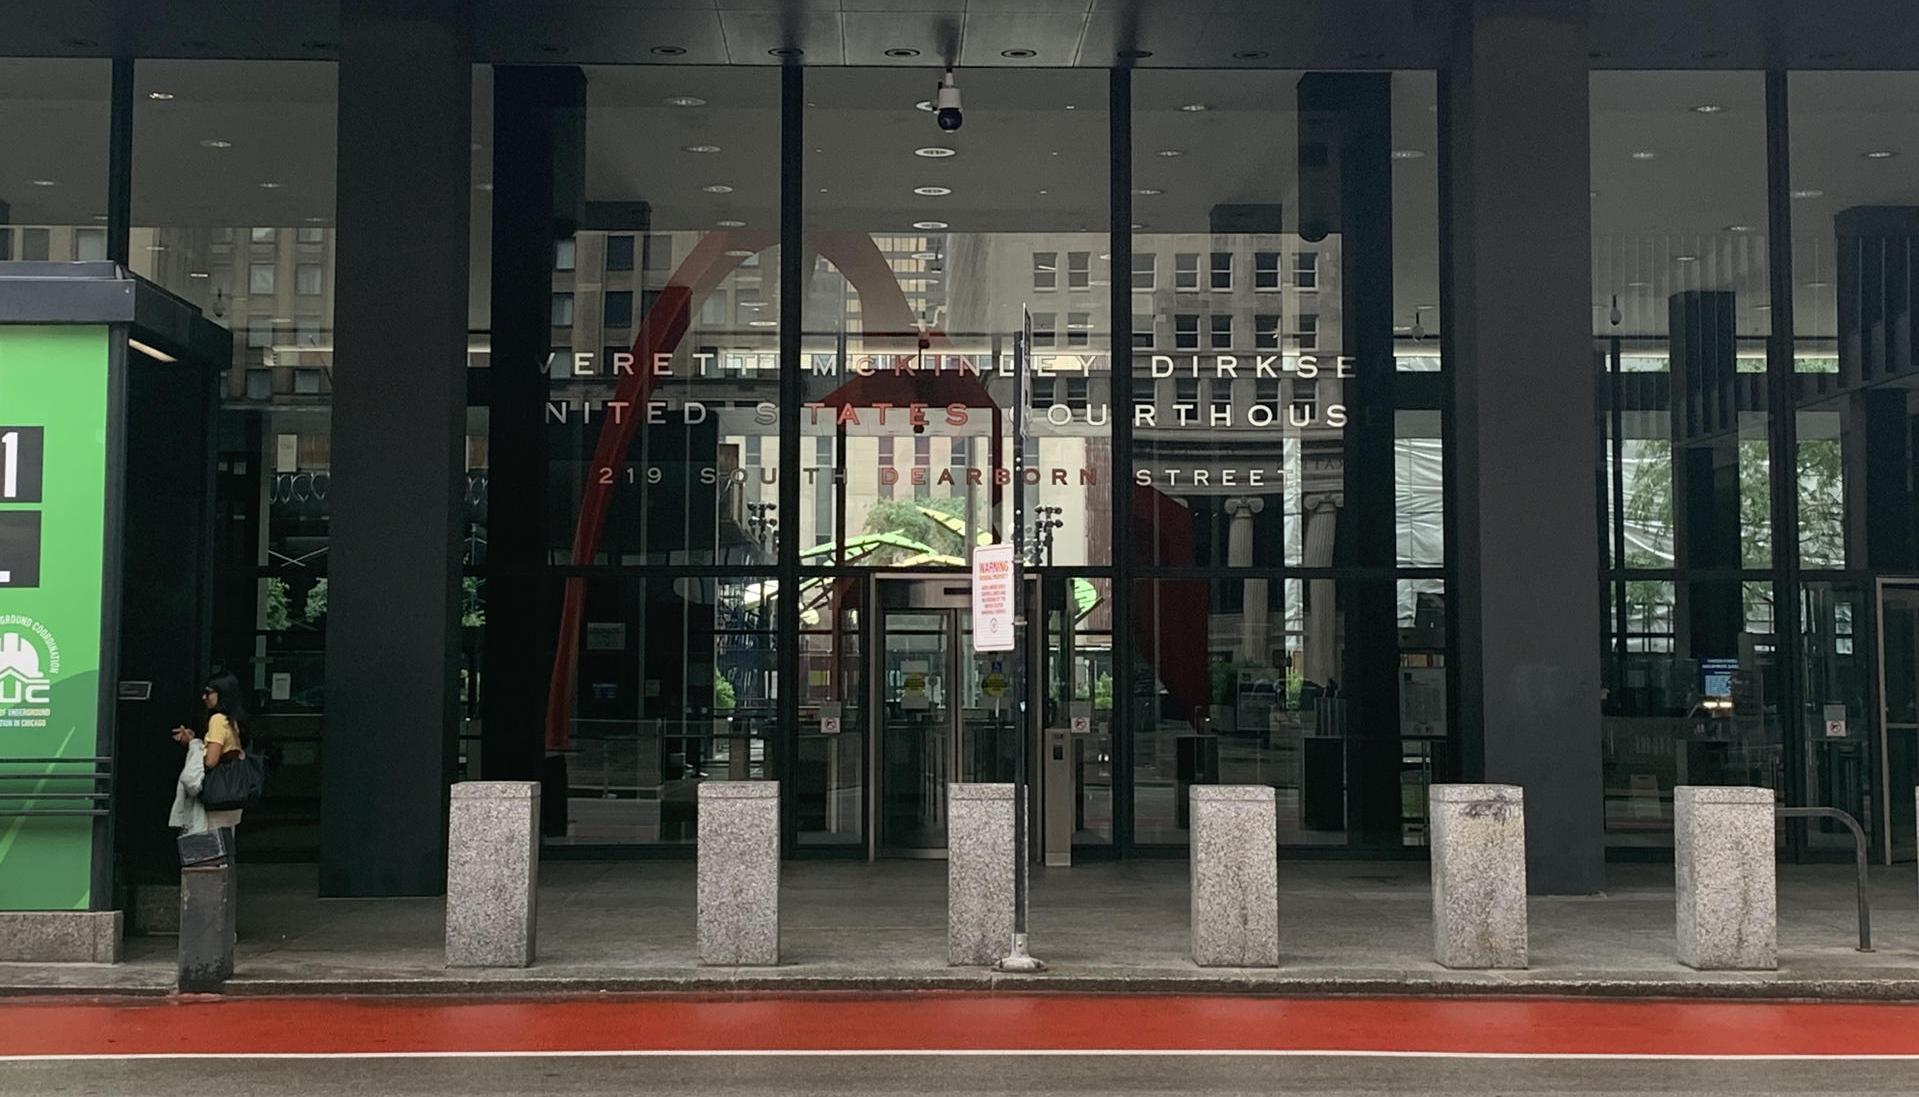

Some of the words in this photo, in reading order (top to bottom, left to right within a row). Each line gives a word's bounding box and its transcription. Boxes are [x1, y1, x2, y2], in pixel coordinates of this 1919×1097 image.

[537, 352, 759, 377] VERETT
[1151, 355, 1357, 379] DIRKSE
[544, 401, 708, 426] NITED
[753, 401, 969, 427] STATES
[1008, 404, 1348, 428] OURTHOUS
[599, 467, 663, 485] 219
[700, 467, 848, 486] SOUTH
[881, 467, 1097, 487] DEARBORN
[1135, 469, 1295, 487] STREET
[979, 560, 1009, 574] WARNING
[32, 622, 60, 674] COORDINATION
[8, 708, 51, 717] UNDERGROUND
[21, 719, 46, 727] CHICAGO
